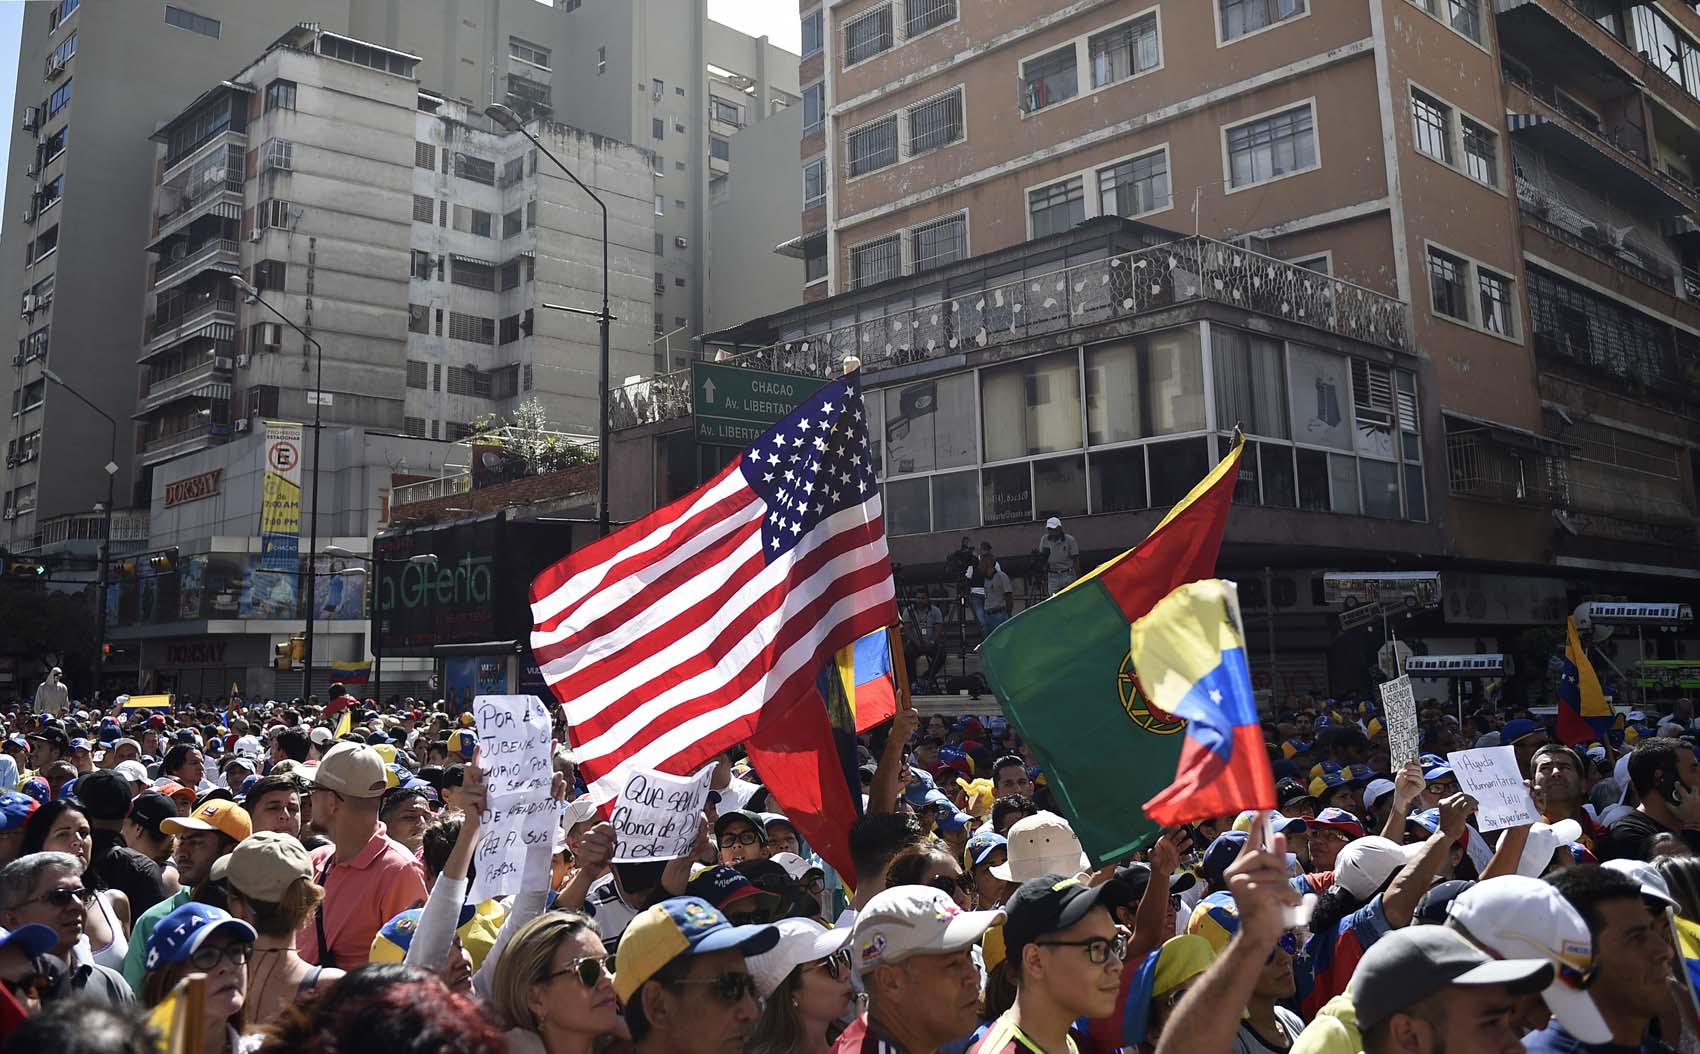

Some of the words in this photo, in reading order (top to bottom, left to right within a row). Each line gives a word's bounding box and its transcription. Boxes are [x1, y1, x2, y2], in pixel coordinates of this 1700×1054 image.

[752, 380, 793, 396] CHACAO
[725, 397, 739, 409] Av.
[700, 424, 714, 436] Av.
[277, 448, 290, 465] E
[165, 470, 221, 506] DORSAY
[479, 703, 516, 730] POR
[481, 808, 502, 825] DE
[658, 816, 675, 838] de
[503, 831, 517, 850] A
[524, 830, 549, 845] SUS
[631, 837, 664, 858] este
